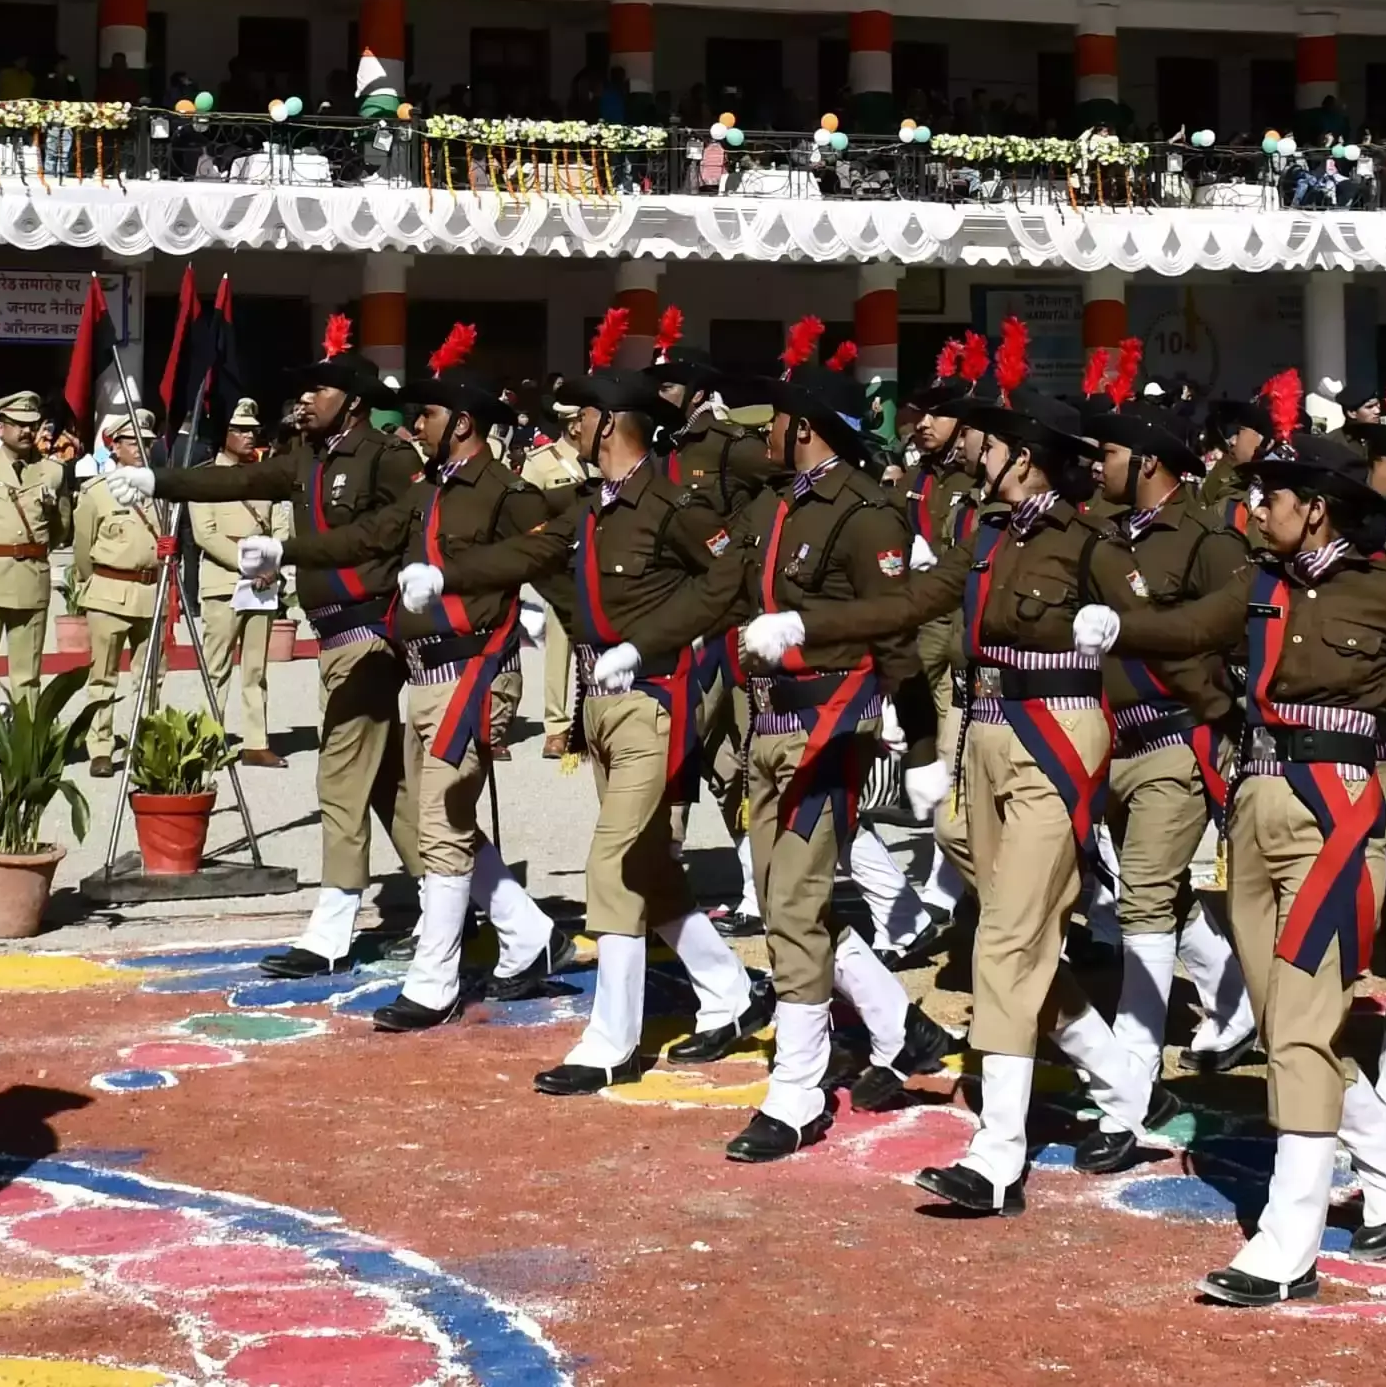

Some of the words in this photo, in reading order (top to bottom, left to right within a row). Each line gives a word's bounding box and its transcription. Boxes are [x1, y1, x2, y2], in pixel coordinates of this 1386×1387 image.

[19, 274, 63, 293] समारोह
[65, 278, 81, 292] पर
[6, 302, 47, 315] जनपद
